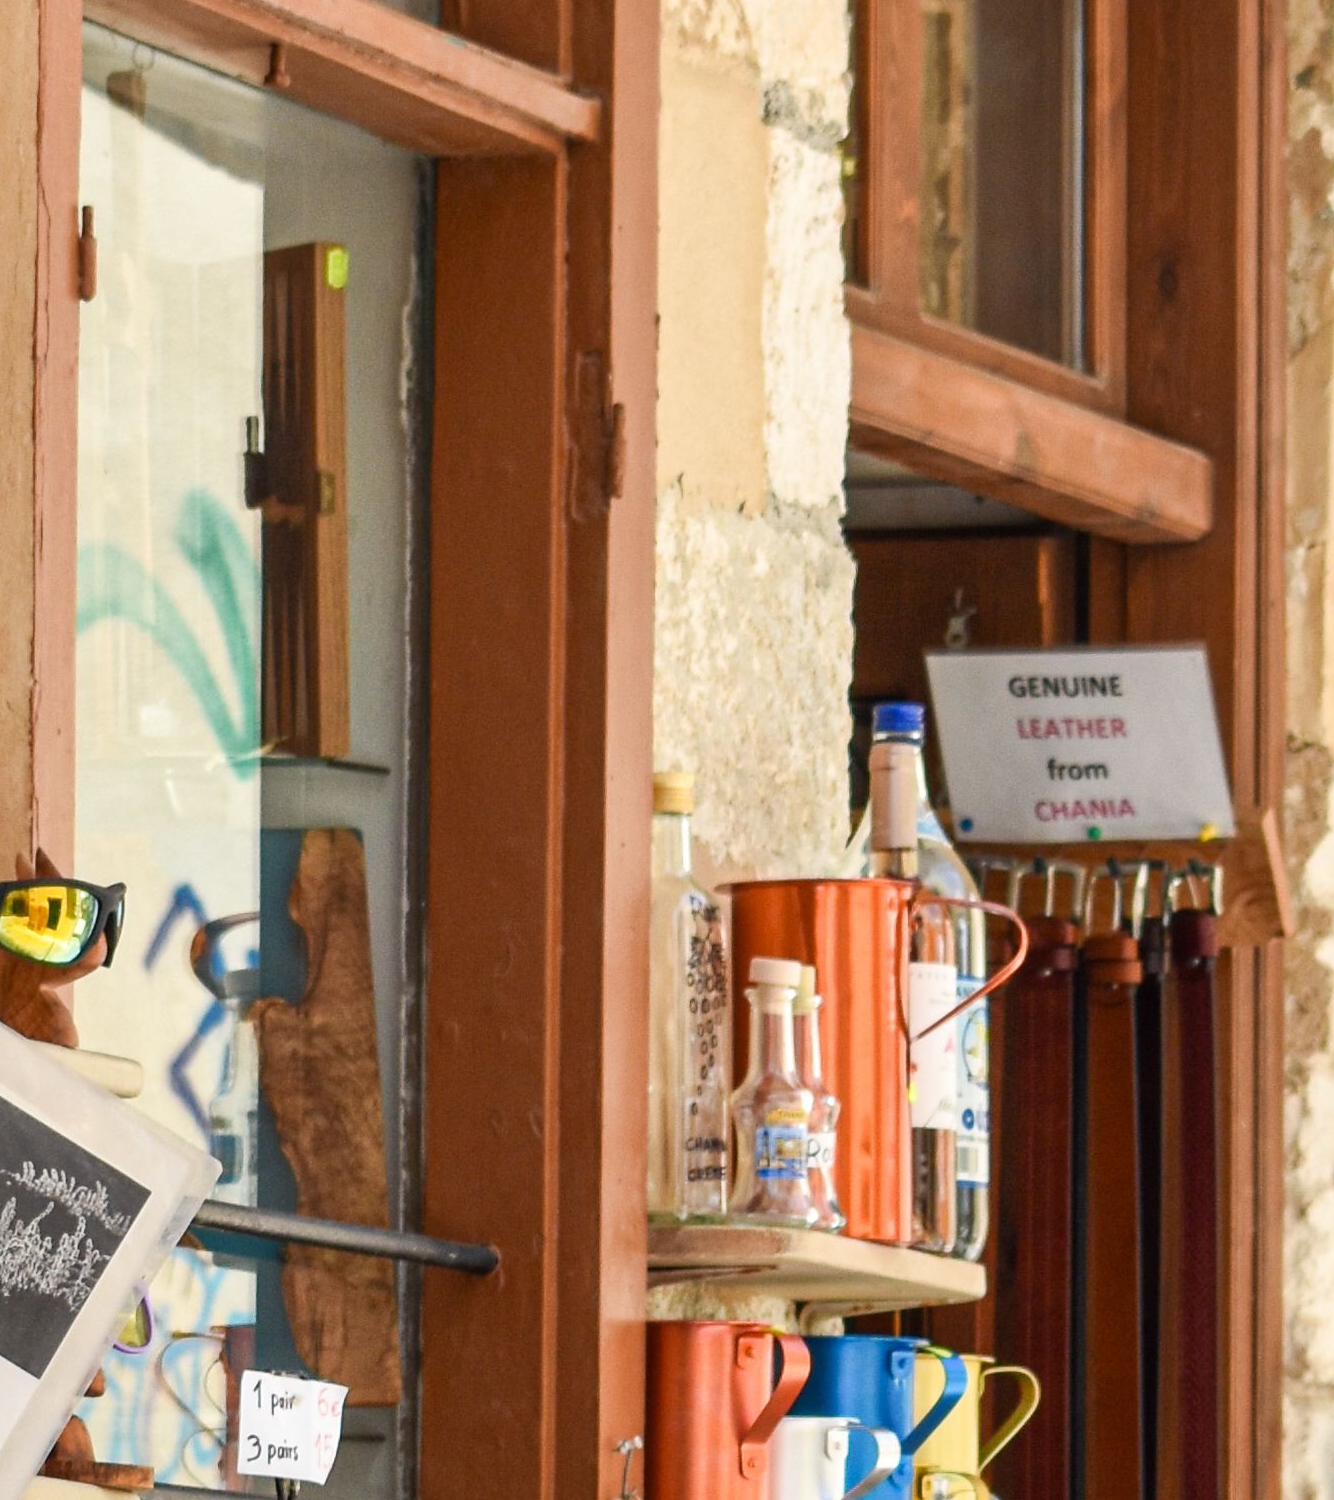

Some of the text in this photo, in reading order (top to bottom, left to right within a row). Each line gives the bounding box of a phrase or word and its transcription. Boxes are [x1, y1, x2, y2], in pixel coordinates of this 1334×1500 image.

[1008, 675, 1123, 698] GENUINE
[1016, 717, 1127, 739] LEATHER
[1047, 758, 1109, 780] from
[1034, 799, 1135, 821] CHANIA
[253, 1379, 262, 1408] 1
[271, 1391, 296, 1416] pair
[247, 1434, 261, 1462] 3
[267, 1439, 298, 1465] pairs
